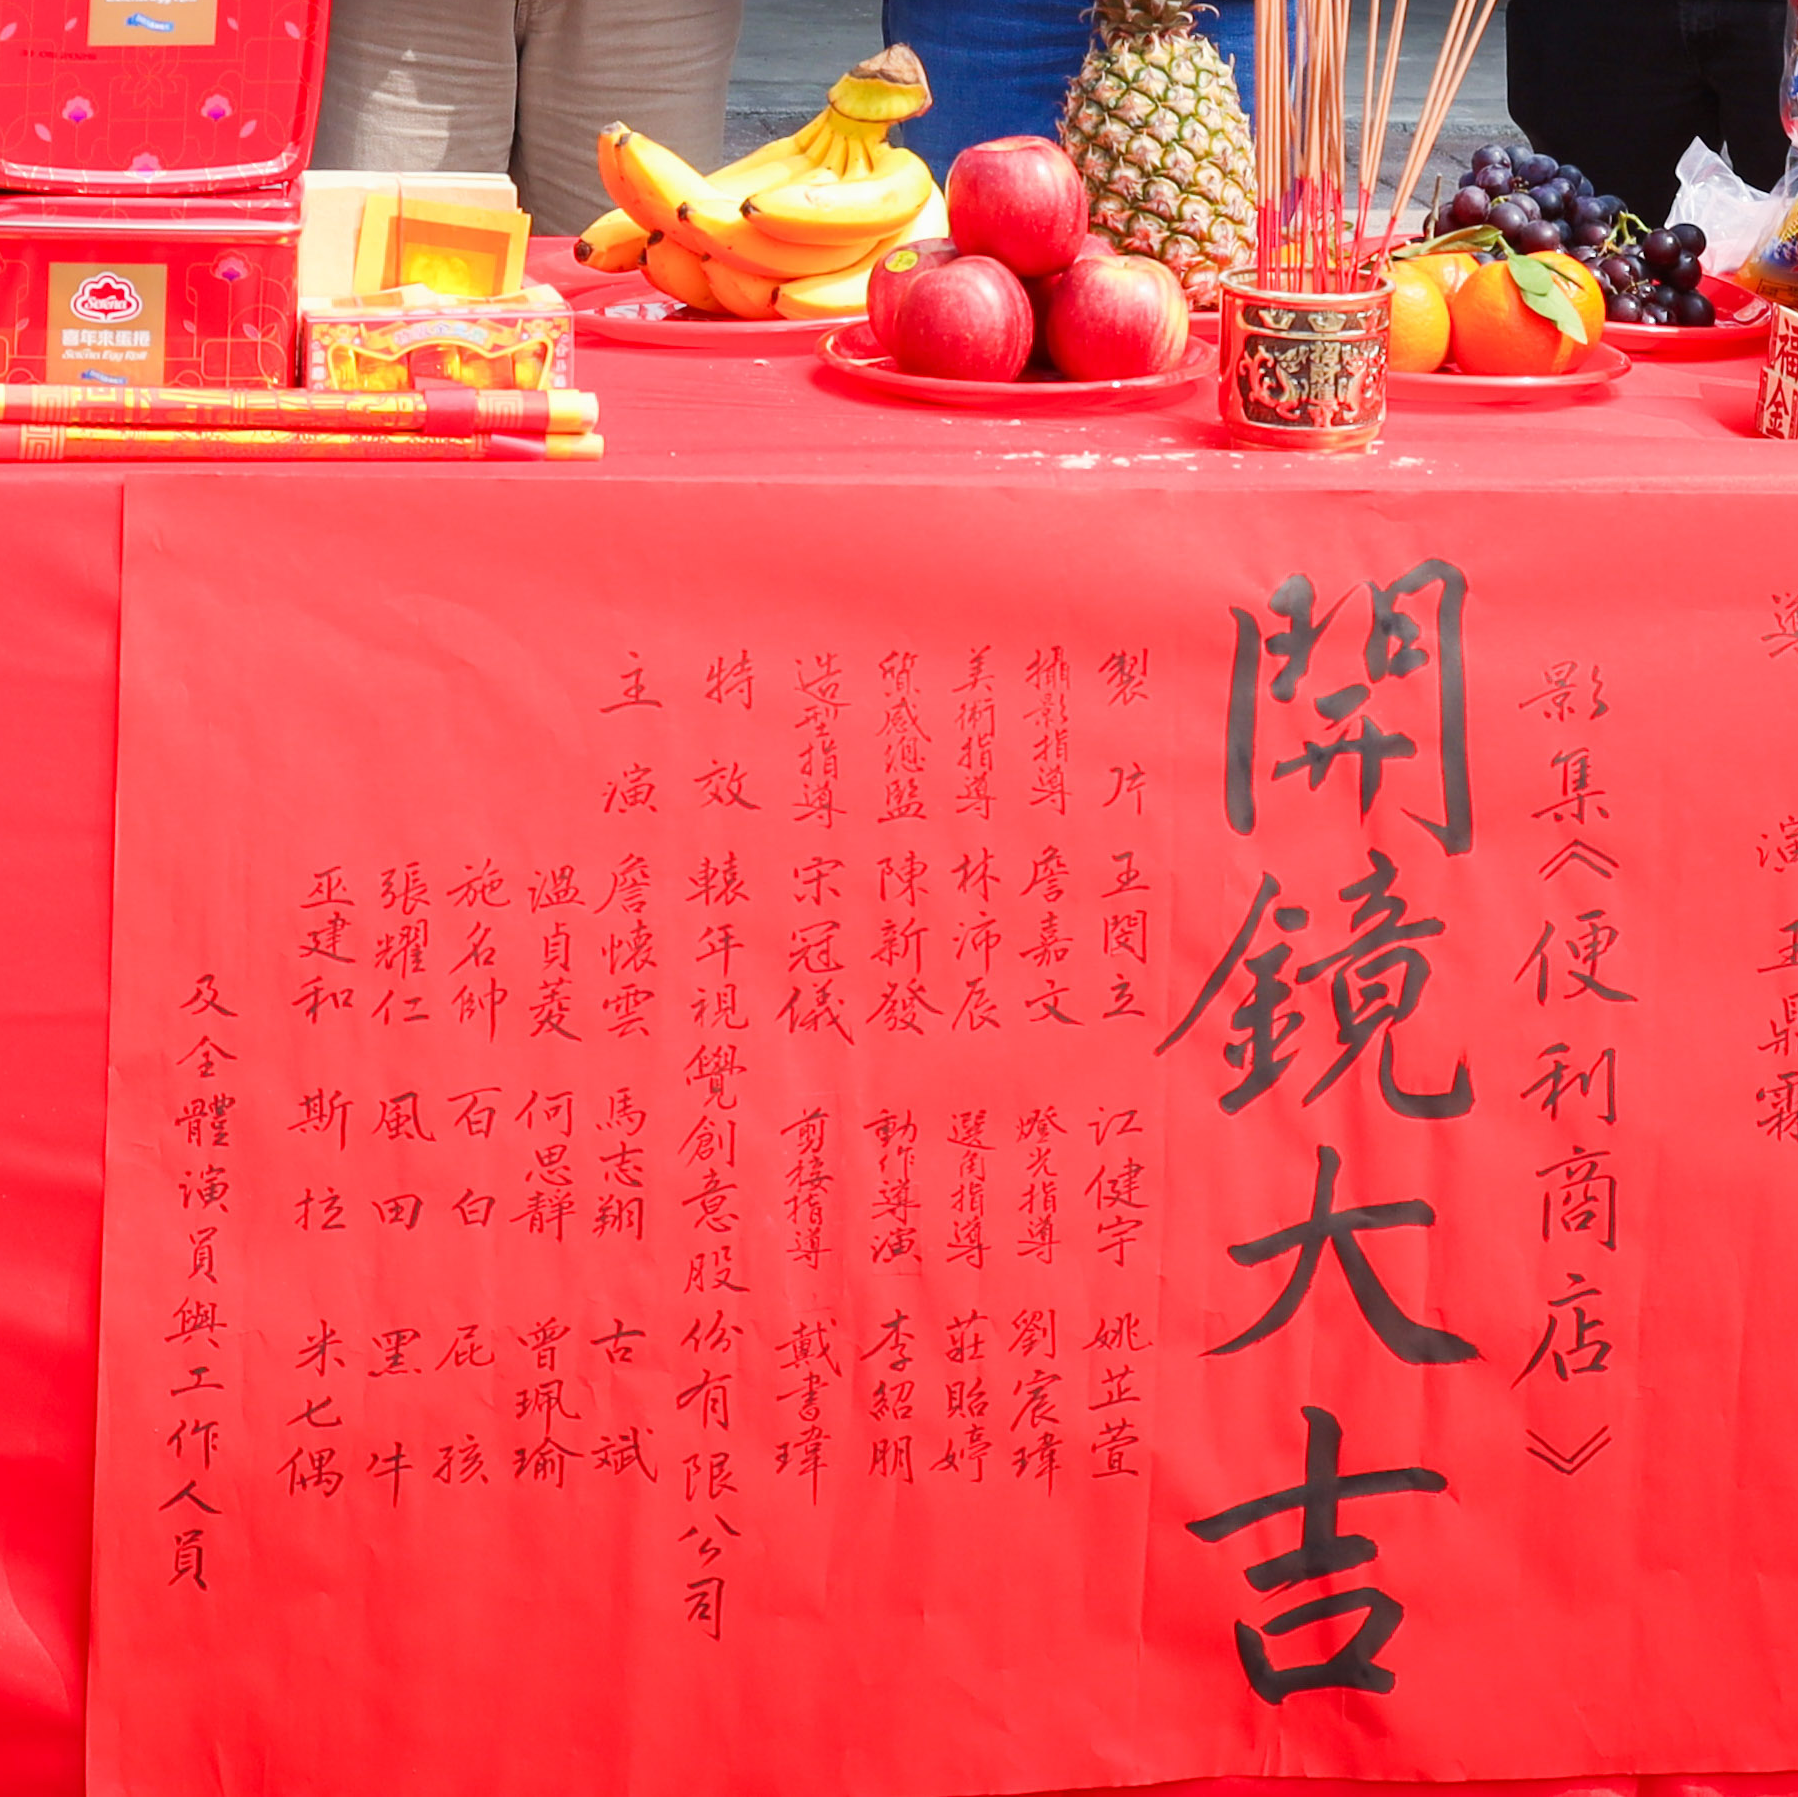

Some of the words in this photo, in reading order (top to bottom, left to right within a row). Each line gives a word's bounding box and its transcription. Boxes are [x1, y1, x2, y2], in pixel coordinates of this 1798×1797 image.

[600, 652, 663, 813] 主演
[694, 649, 761, 810] 特效
[371, 1091, 436, 1230] 風田
[1154, 558, 1488, 1705] 開鏡大吉
[432, 1324, 495, 1484] 屁孩
